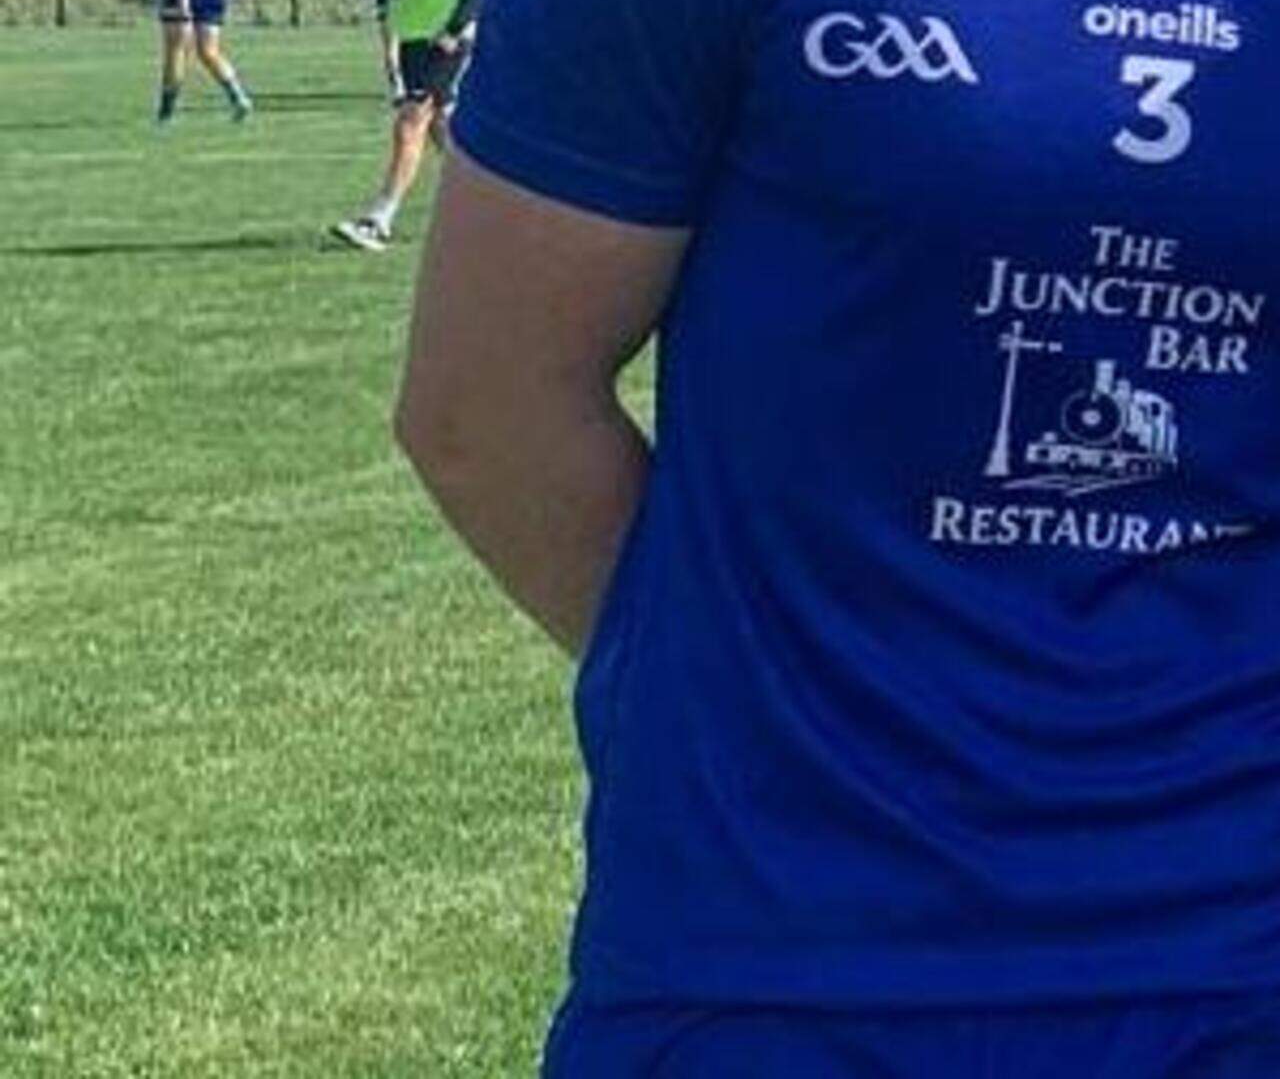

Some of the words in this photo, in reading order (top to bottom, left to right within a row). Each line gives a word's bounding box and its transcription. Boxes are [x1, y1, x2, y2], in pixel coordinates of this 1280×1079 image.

[804, 12, 979, 85] GAA
[1110, 55, 1196, 164] 3
[1091, 224, 1179, 271] THE
[975, 257, 1266, 325] JUNCTION
[1144, 327, 1249, 375] BAR
